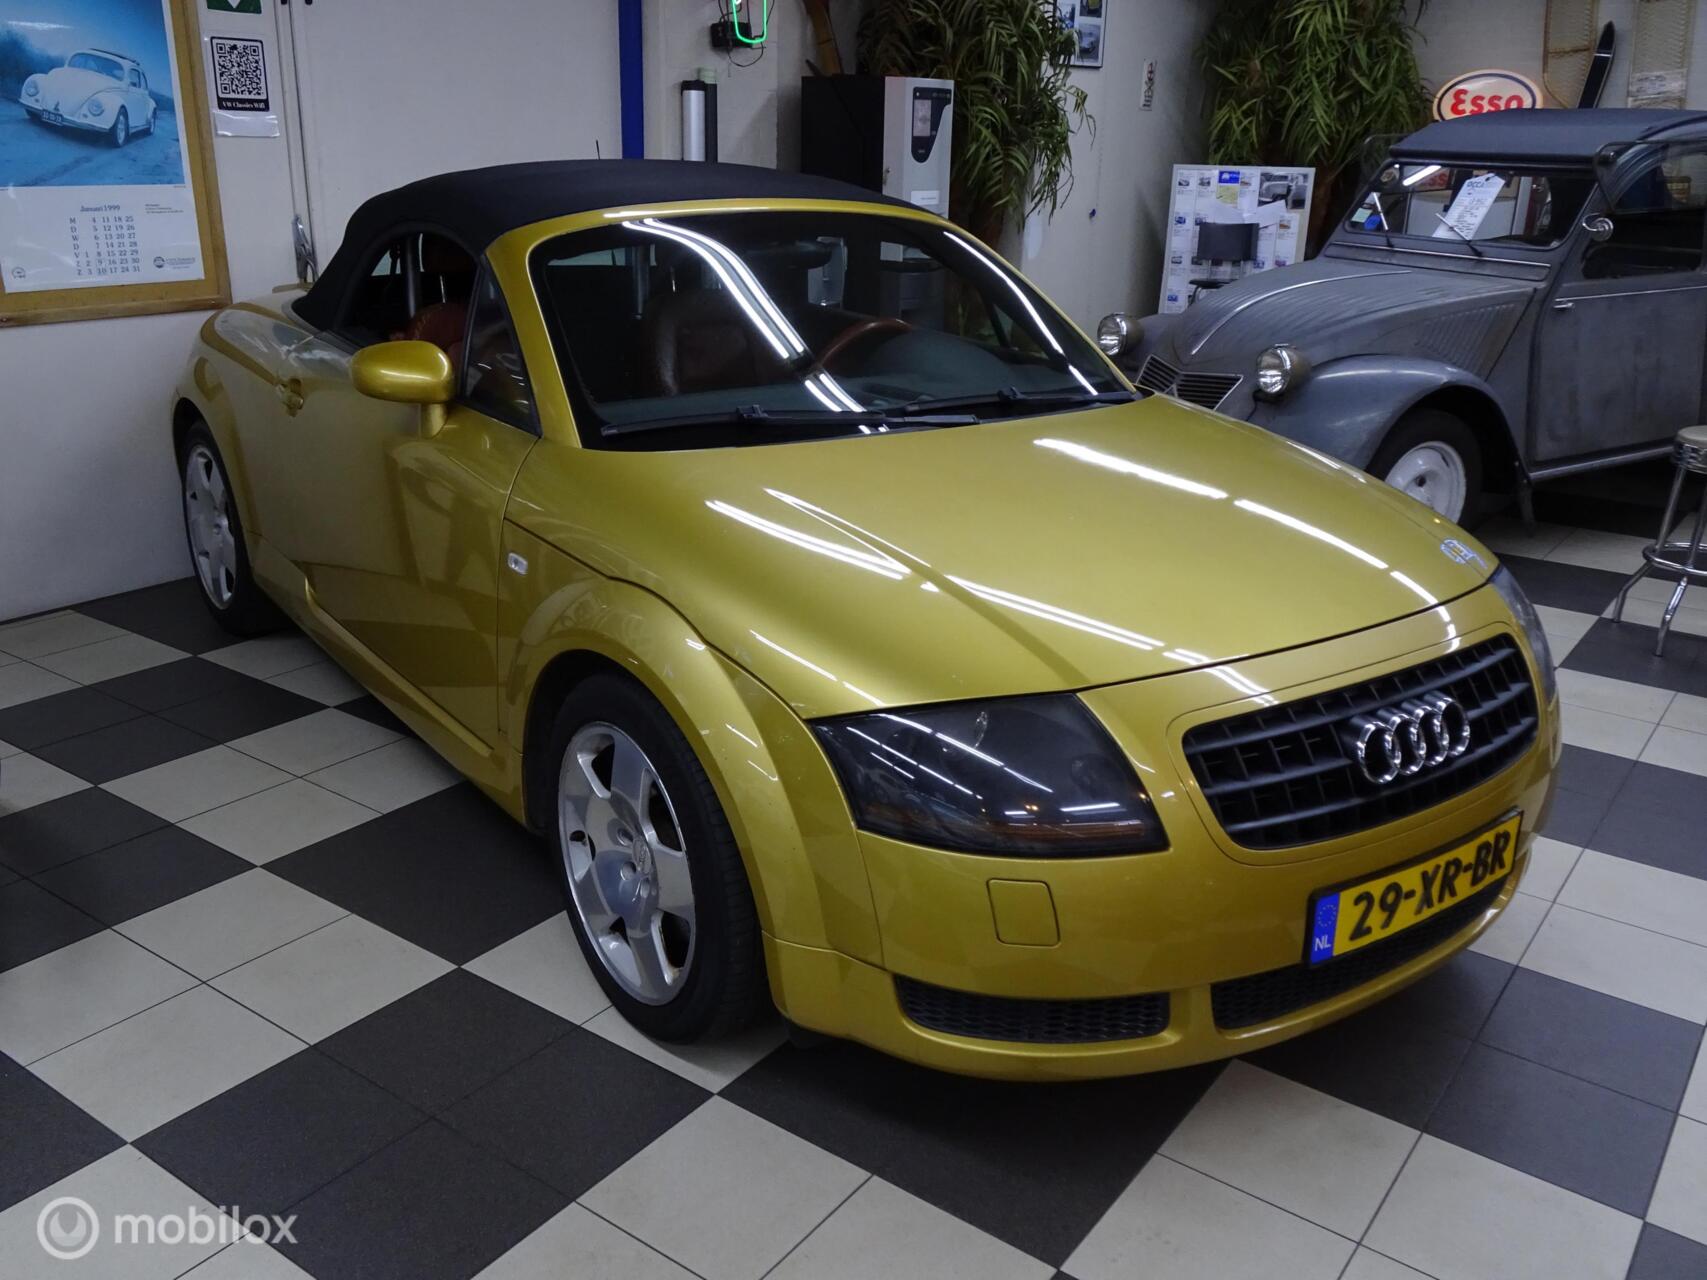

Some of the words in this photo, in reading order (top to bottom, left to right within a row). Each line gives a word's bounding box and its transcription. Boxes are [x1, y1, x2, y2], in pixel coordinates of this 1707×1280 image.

[103, 204, 120, 212] 1999
[1350, 831, 1511, 941] 29-XR-BR
[1314, 935, 1331, 951] NL
